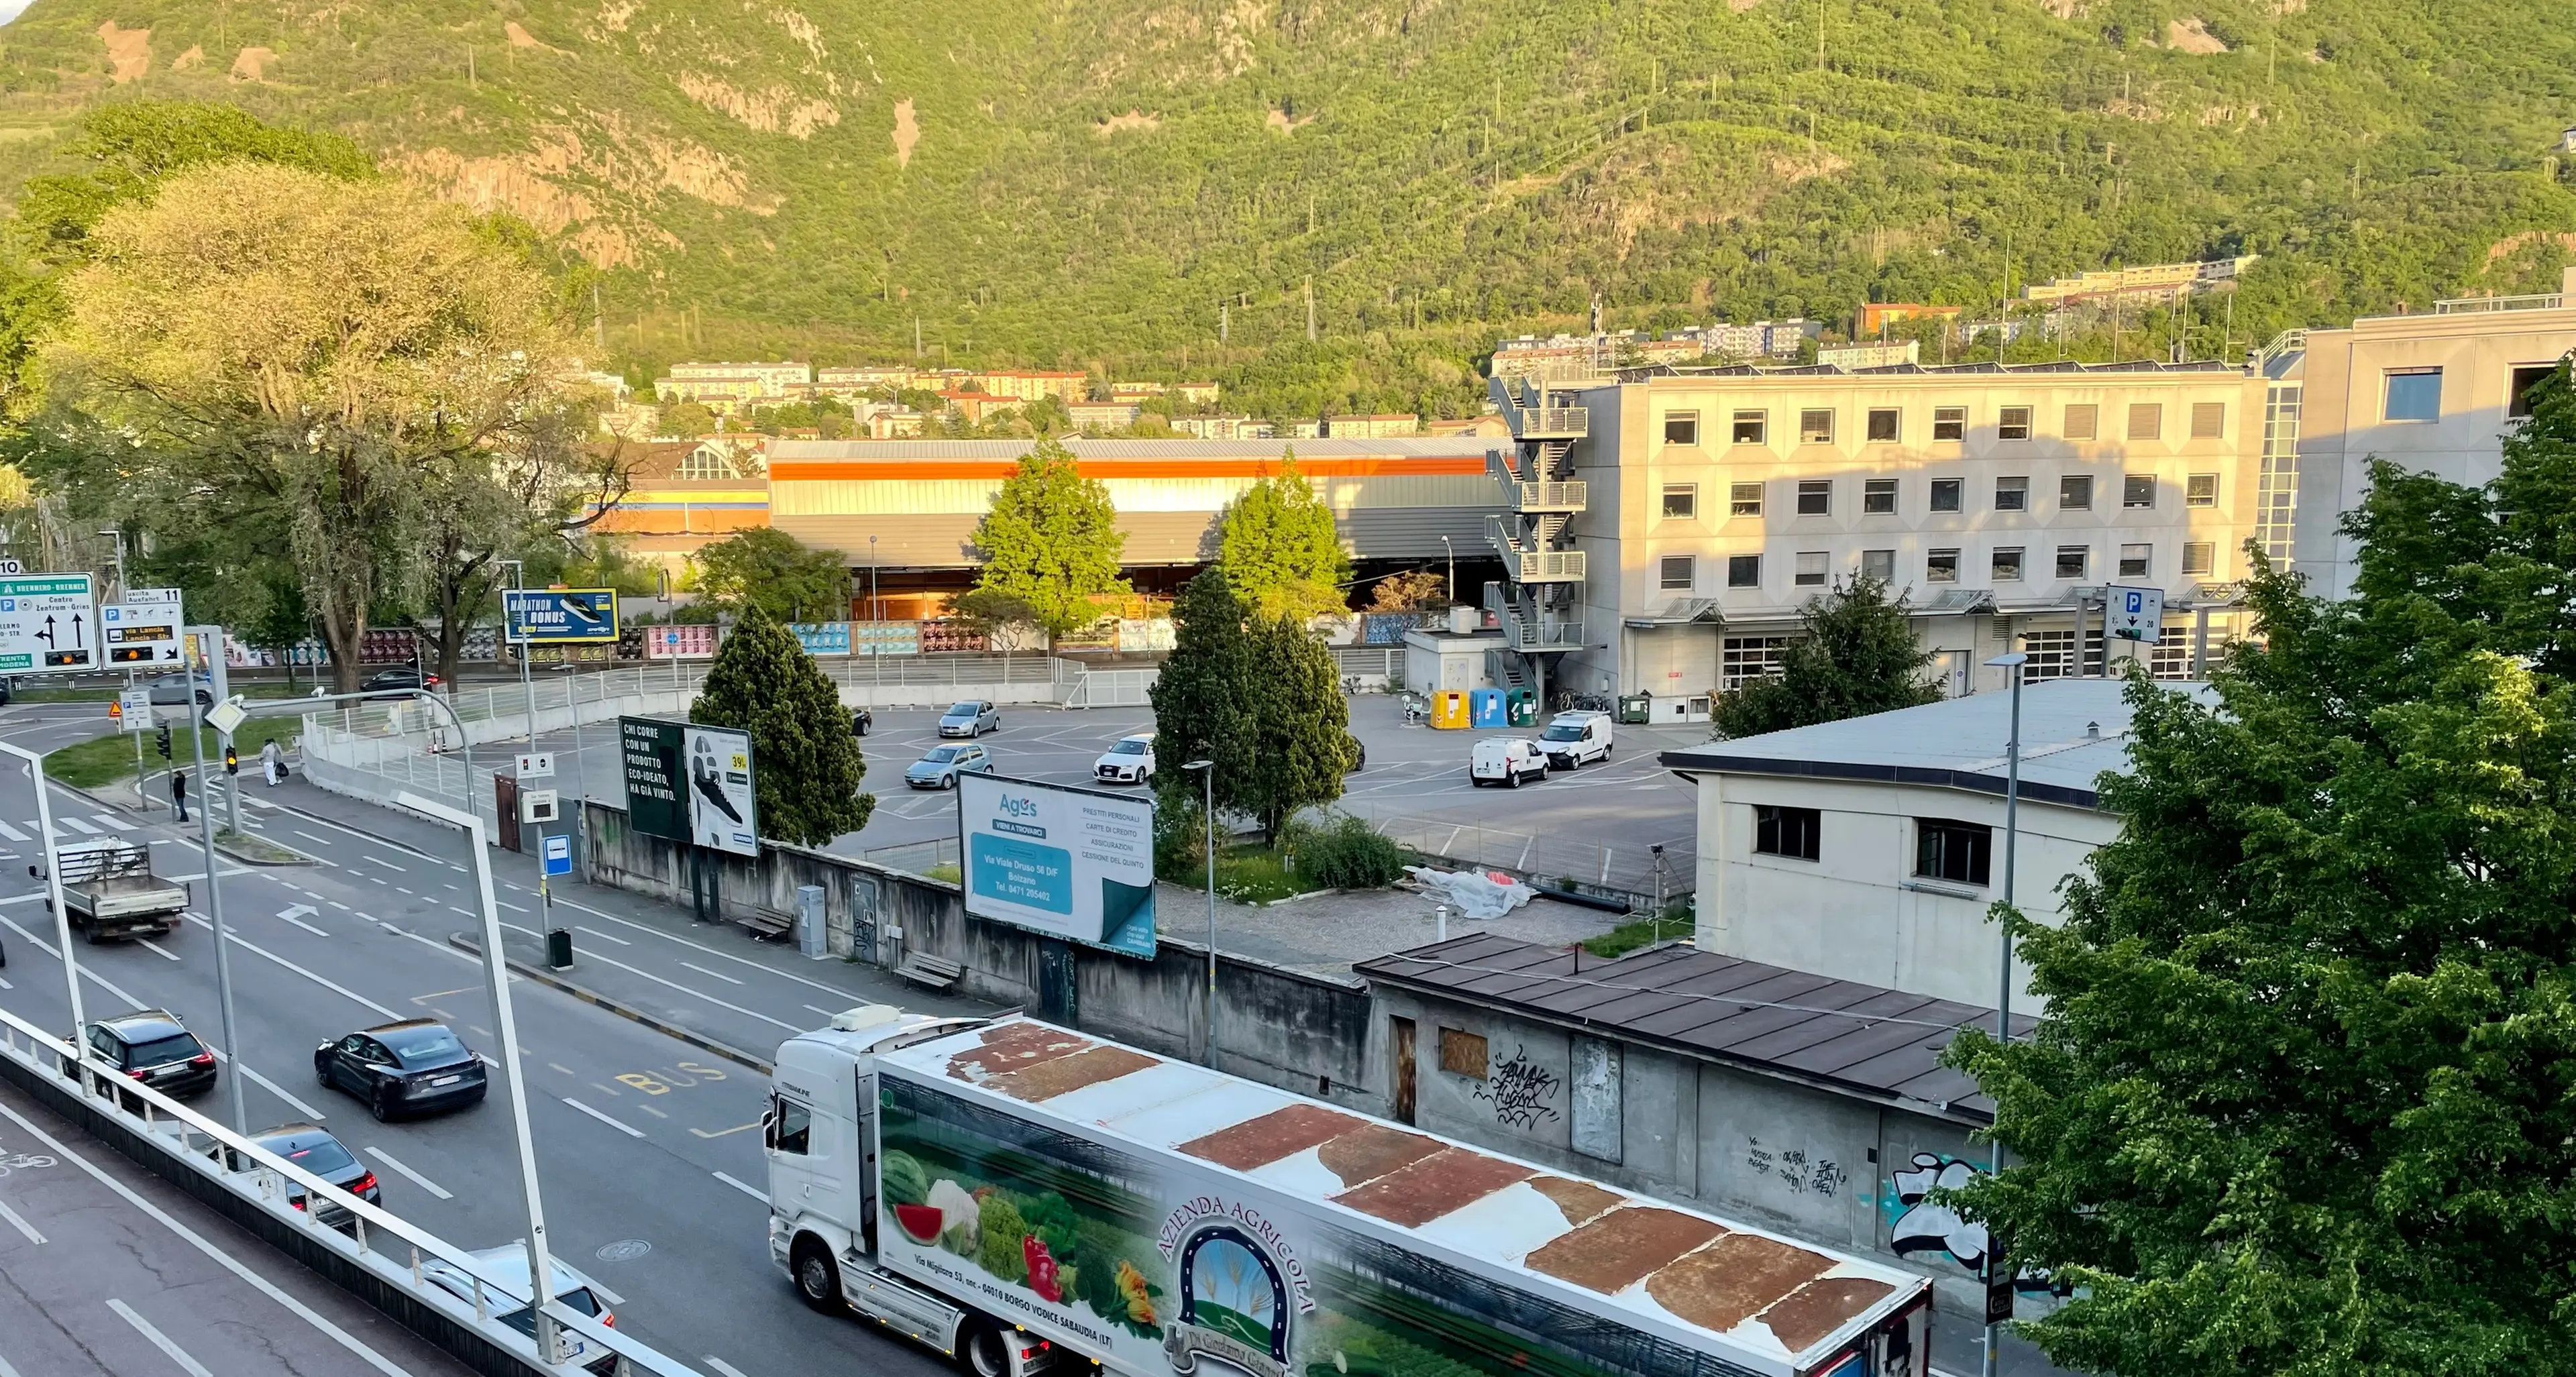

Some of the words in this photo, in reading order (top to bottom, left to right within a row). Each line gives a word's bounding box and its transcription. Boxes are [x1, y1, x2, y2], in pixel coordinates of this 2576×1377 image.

[0, 561, 17, 573] 10
[165, 590, 178, 600] 11
[511, 599, 551, 611] MARATHON
[530, 611, 566, 624] BONUS
[2147, 620, 2154, 628] 20
[624, 724, 636, 735] CHI
[637, 726, 659, 738] CORRE
[625, 738, 639, 751] CON
[640, 740, 650, 752] UN
[627, 753, 661, 769] PRODOTTO
[630, 783, 640, 794] HA
[1083, 807, 1107, 818] PRESTITI
[1108, 812, 1140, 823] PERSONALI
[1016, 826, 1043, 836] TROVARCI
[1086, 823, 1104, 832] CARTE
[1112, 827, 1137, 838] CREDITO
[1091, 838, 1134, 852] ASSICURAZIONI
[984, 854, 995, 864] Via
[996, 857, 1012, 868] Viale
[1014, 861, 1035, 873] Druso
[1081, 851, 1109, 863] CESSIONE
[1110, 856, 1122, 865] DEL
[1122, 859, 1144, 869] QUINTO
[1008, 871, 1036, 885] Bolzano
[996, 881, 1007, 891] Tel.
[1008, 884, 1025, 896] 0471
[614, 1062, 725, 1095] BUS
[1158, 1196, 1226, 1258] AZIENDA
[1230, 1202, 1315, 1312] AGRICOLA
[914, 1254, 926, 1266] Via
[1004, 1292, 1030, 1311] BORGO
[1031, 1303, 1059, 1324] VODICE
[1060, 1317, 1097, 1342] SABAUDIA
